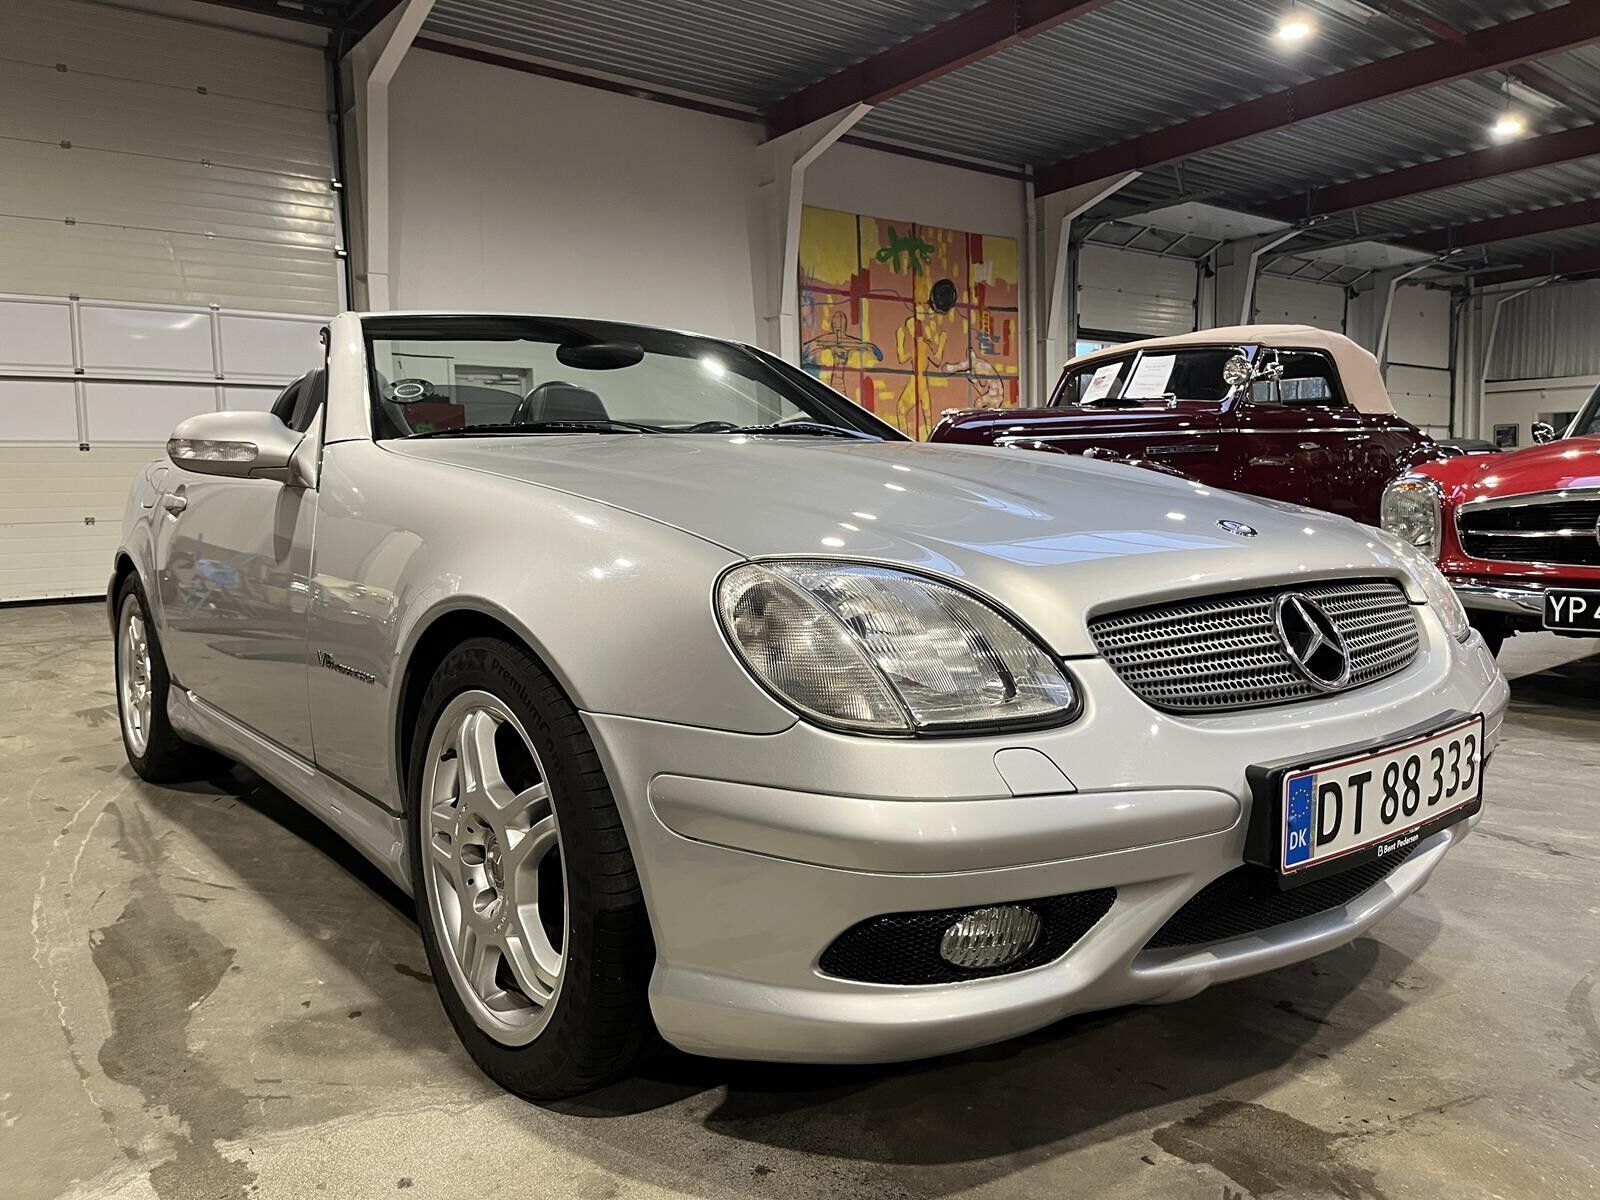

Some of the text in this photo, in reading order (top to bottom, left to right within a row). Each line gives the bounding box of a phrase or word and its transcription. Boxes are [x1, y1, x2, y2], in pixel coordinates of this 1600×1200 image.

[1549, 596, 1587, 623] YP
[1316, 734, 1476, 847] DT 88 333
[1289, 828, 1307, 851] DK
[1383, 842, 1396, 854] Bent
[1396, 834, 1419, 849] Pedersen
